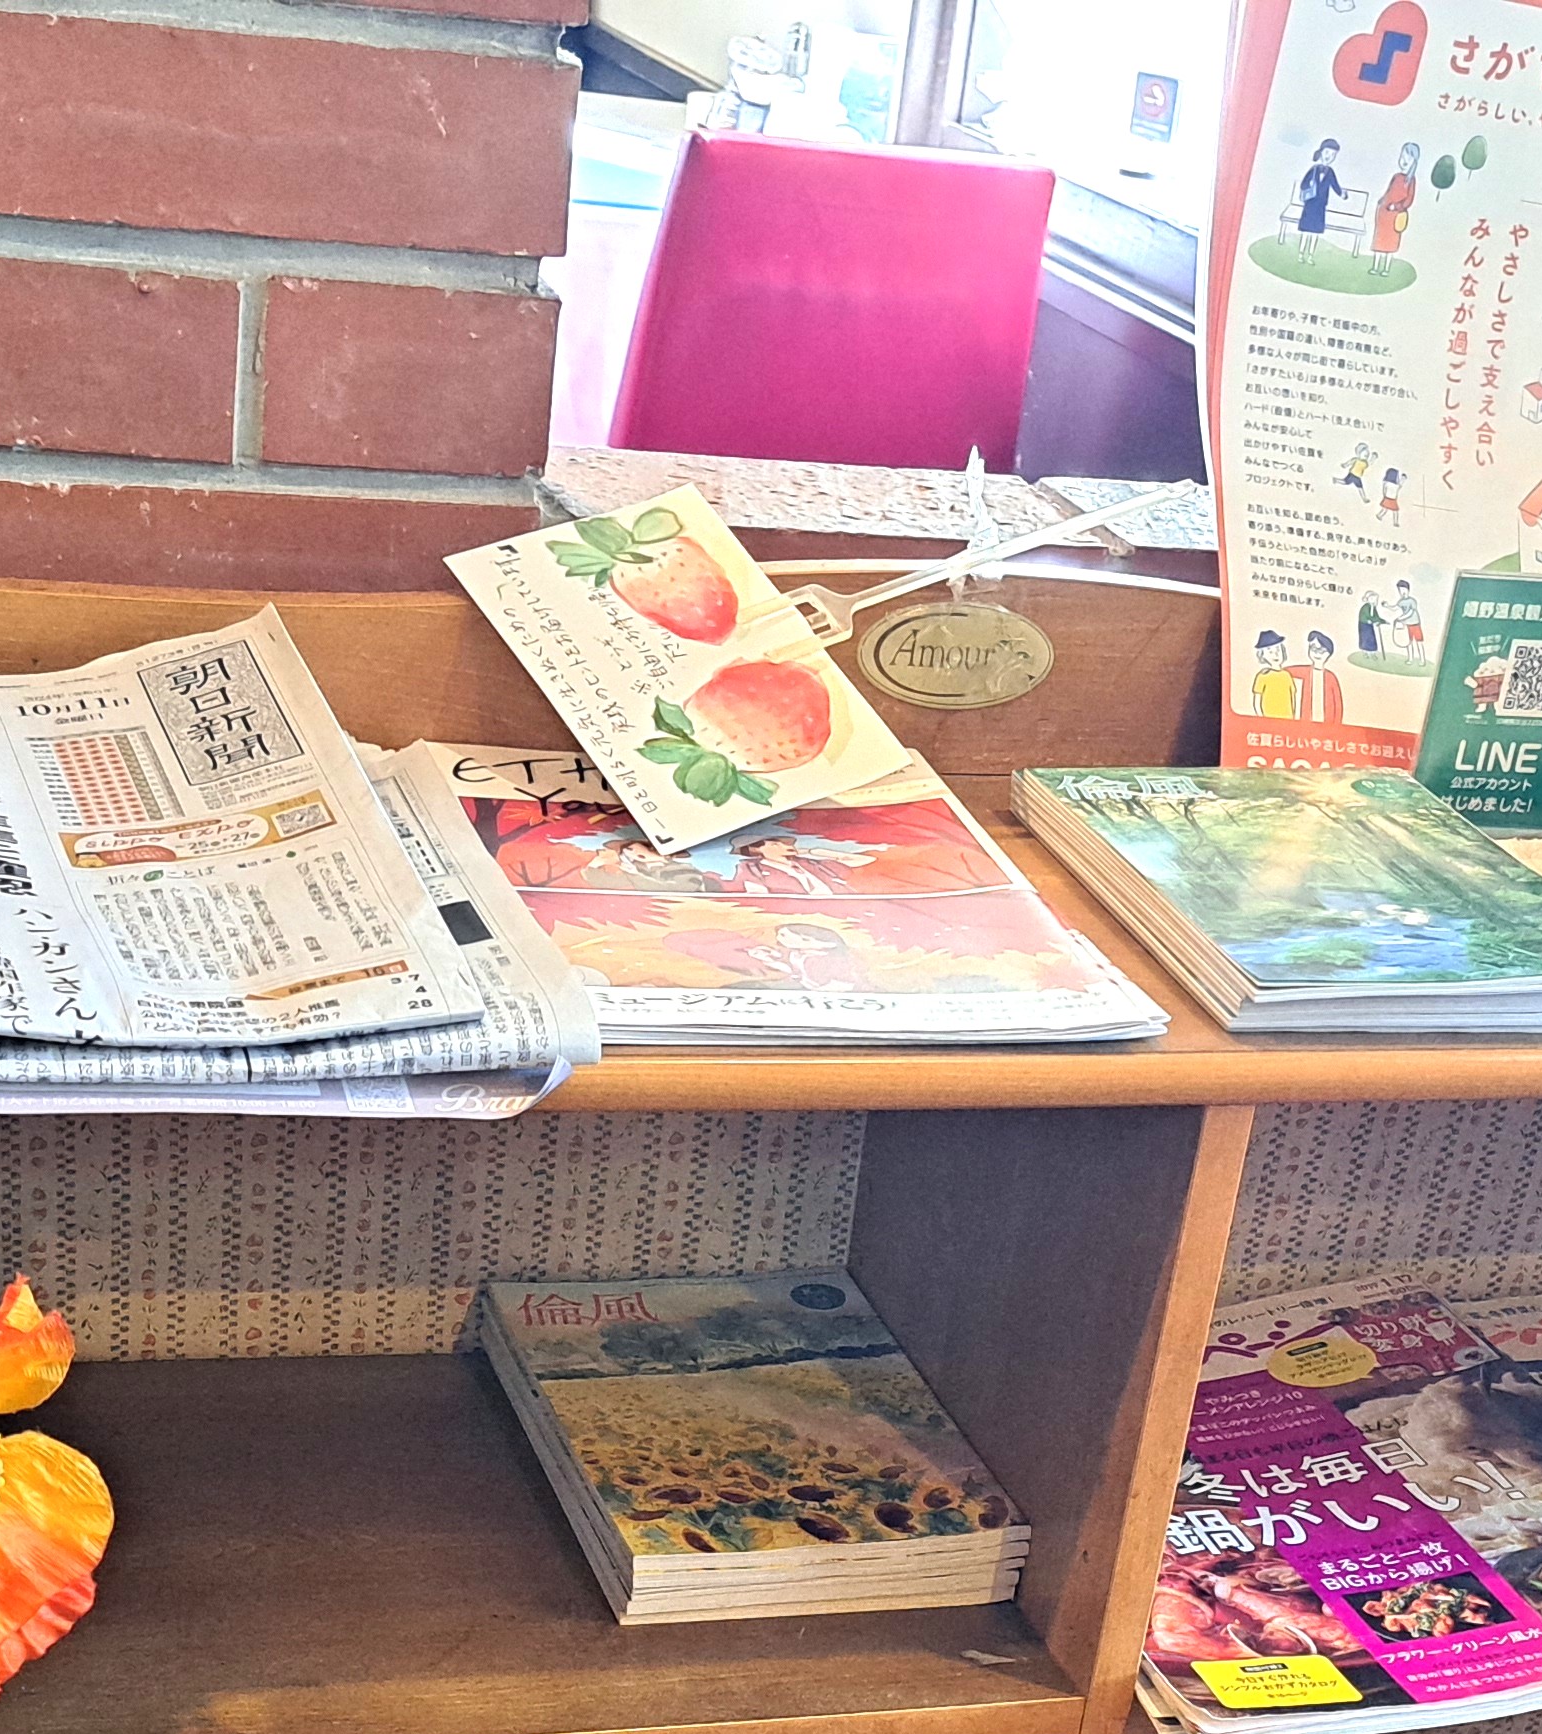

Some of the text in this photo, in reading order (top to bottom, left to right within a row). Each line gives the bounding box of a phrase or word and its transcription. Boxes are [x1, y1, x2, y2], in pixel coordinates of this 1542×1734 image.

[1440, 217, 1492, 491] みんなが過ごしやすく
[1474, 222, 1529, 468] やさしさで支え合い
[1244, 420, 1312, 439] みんなが安心して
[1244, 456, 1304, 473] みんなでつくる
[1245, 473, 1315, 493] プロジェクトです。
[16, 696, 131, 718] 10月11日
[164, 657, 271, 771] 朝日新聞
[1454, 739, 1542, 774] LINE
[1450, 776, 1533, 791] 公式アカウント
[408, 999, 434, 1010] 28
[516, 1291, 659, 1328] 倫風
[1179, 1436, 1429, 1503] 冬は毎日
[1162, 1459, 1531, 1557] 鍋がいい!
[1318, 1541, 1449, 1576] まるごと一枚
[1319, 1555, 1470, 1592] BIGから揚げ!
